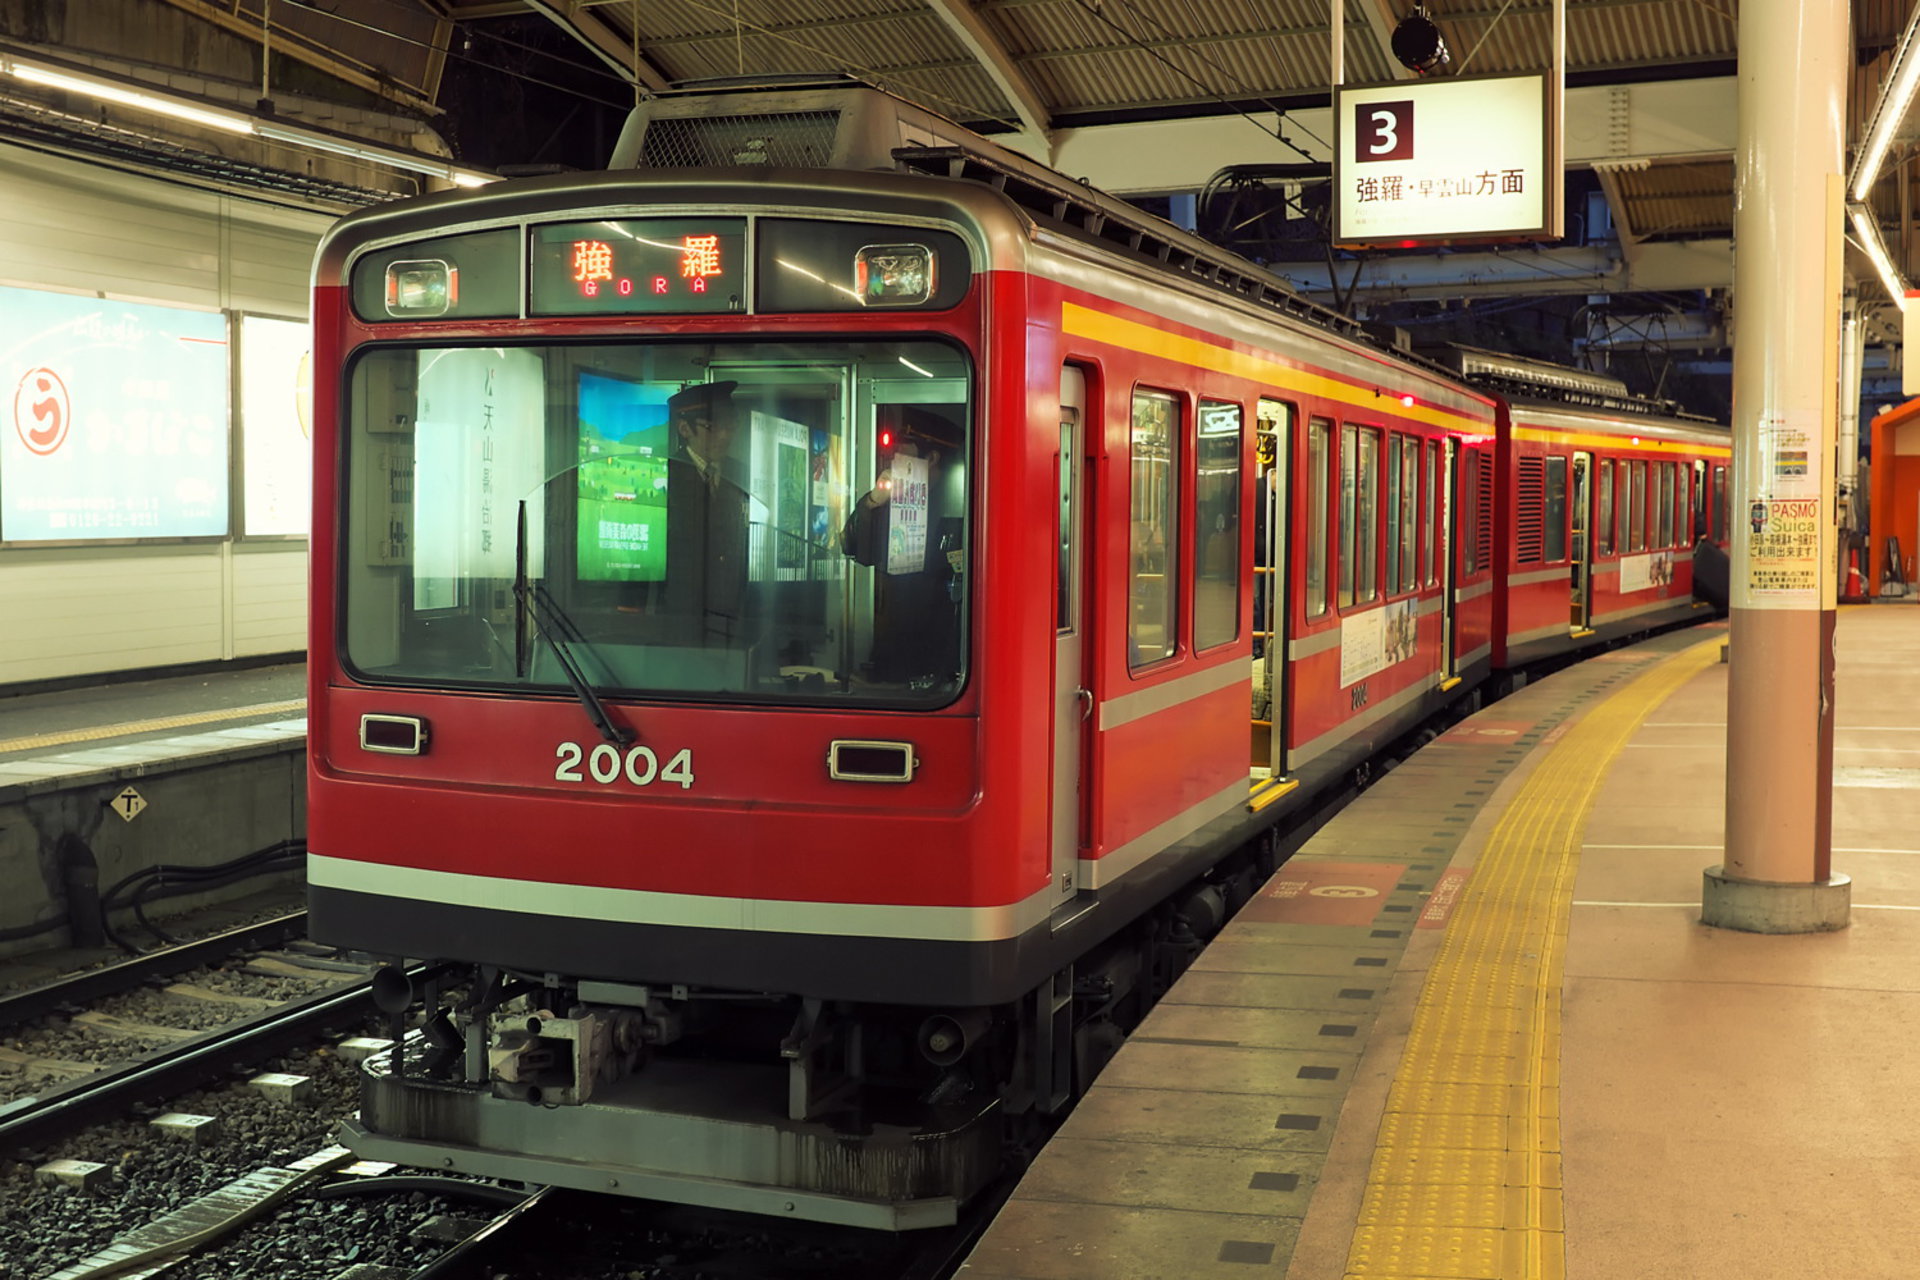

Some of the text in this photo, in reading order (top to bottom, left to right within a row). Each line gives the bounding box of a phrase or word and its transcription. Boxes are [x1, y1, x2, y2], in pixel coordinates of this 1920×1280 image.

[1369, 110, 1398, 155] 3
[584, 277, 706, 296] GORA
[1771, 502, 1817, 518] PASMO
[1771, 517, 1815, 533] Suica
[554, 741, 695, 790] 2004
